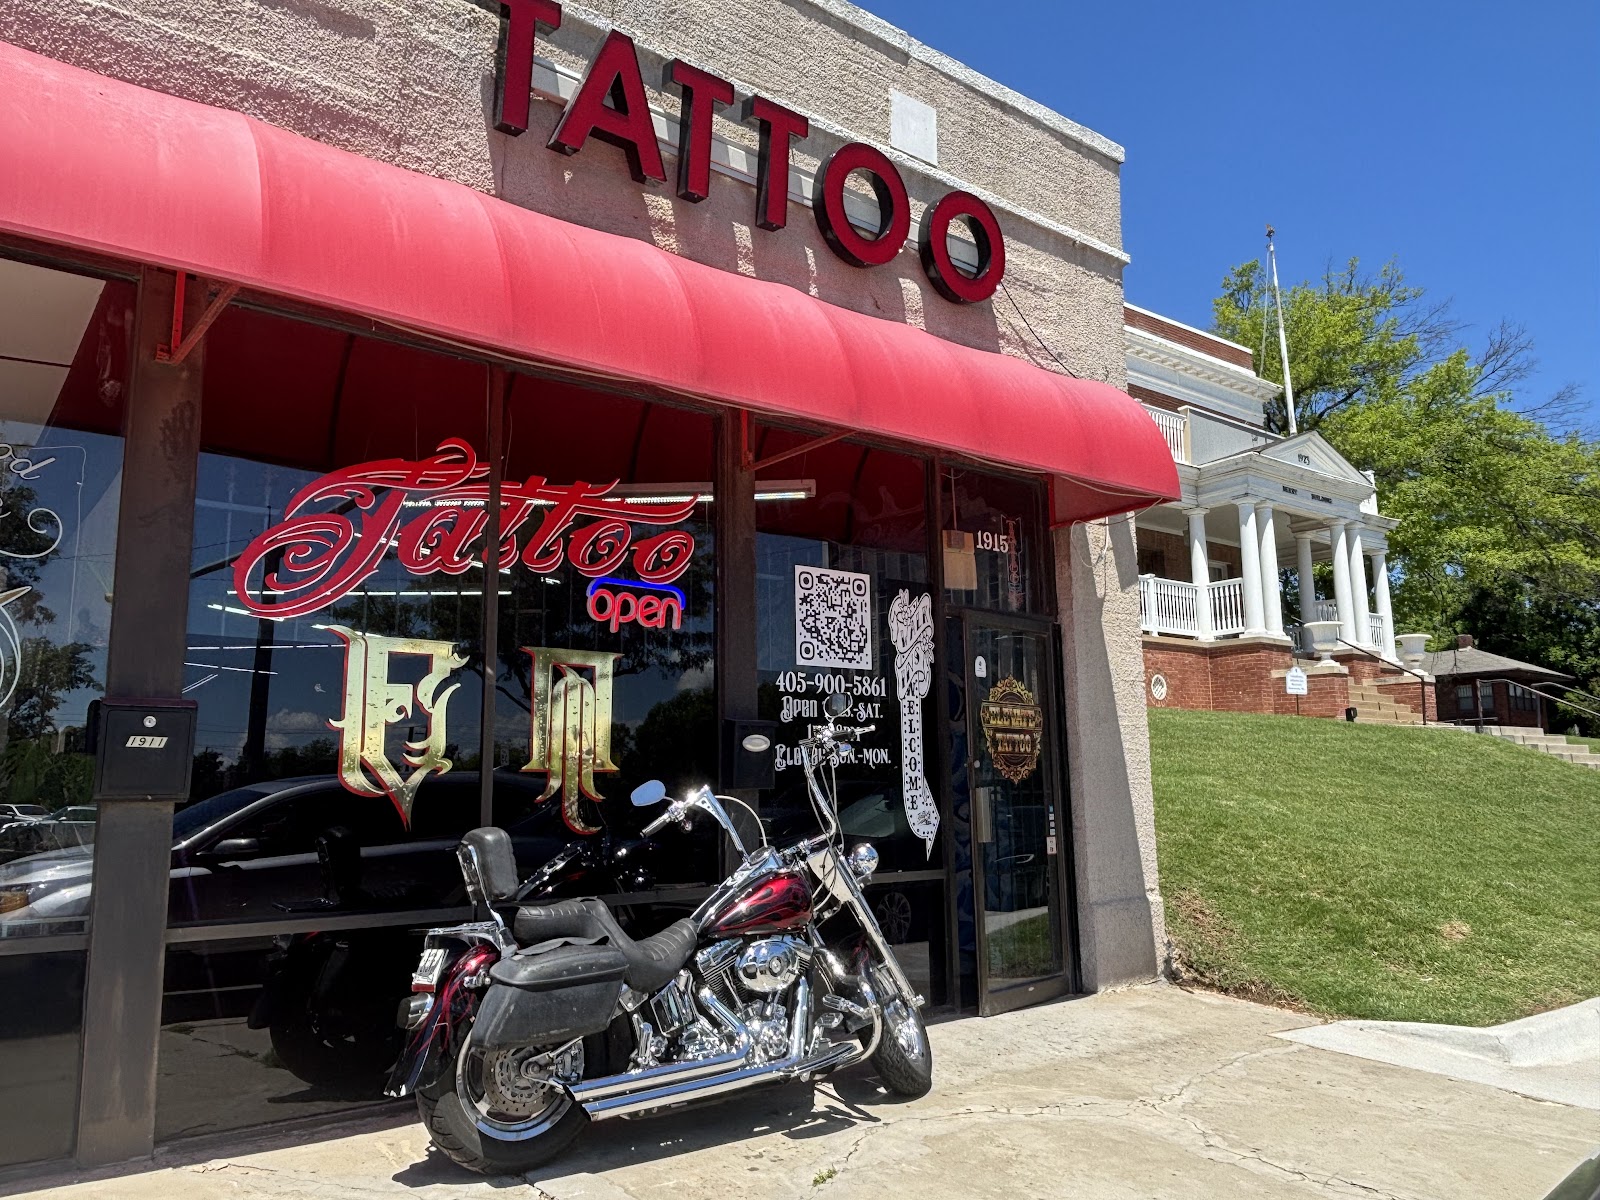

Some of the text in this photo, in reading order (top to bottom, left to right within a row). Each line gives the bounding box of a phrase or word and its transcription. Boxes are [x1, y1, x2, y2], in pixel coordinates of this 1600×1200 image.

[494, 0, 1005, 303] TATTOO
[233, 437, 700, 619] Tattoo
[976, 530, 1009, 554] 1915
[775, 671, 887, 698] 405-900-5861
[130, 736, 165, 747] 1911
